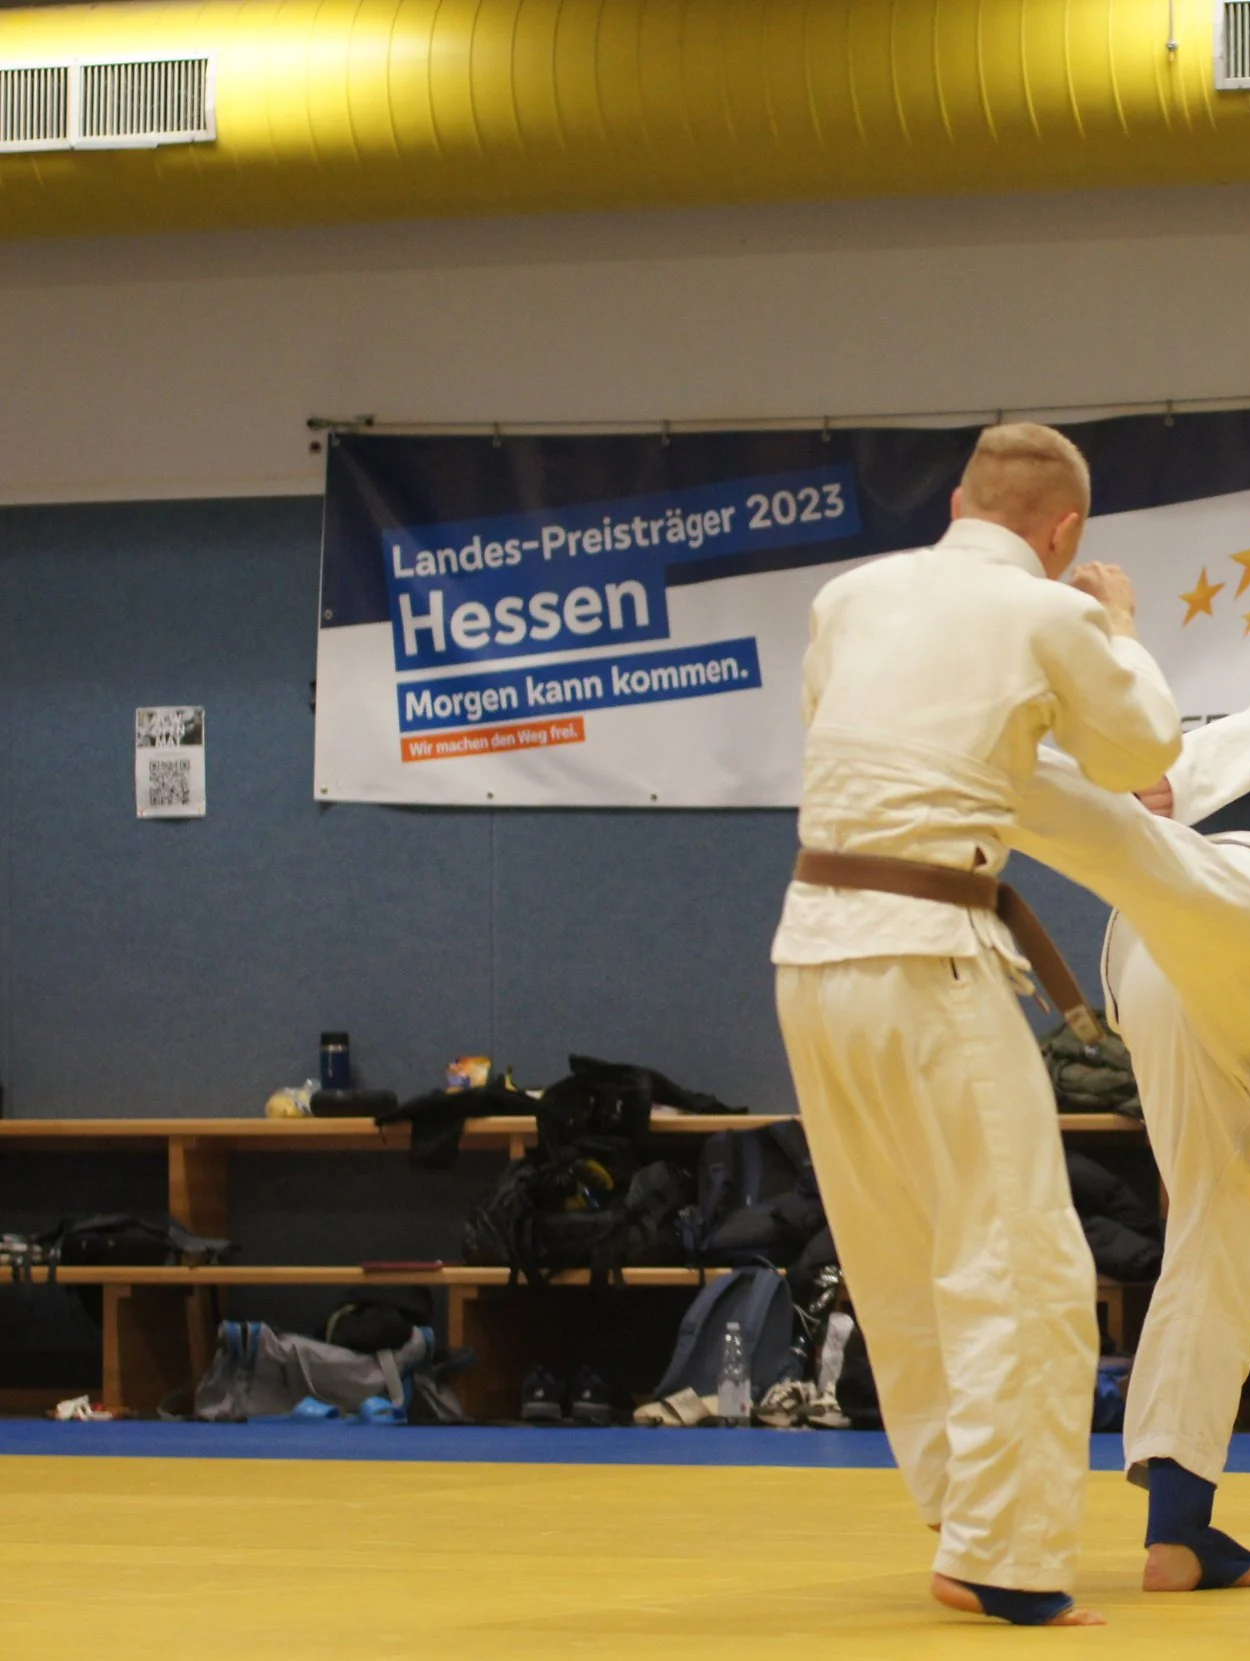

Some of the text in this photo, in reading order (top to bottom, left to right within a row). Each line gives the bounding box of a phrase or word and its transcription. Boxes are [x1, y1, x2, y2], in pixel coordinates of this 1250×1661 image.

[392, 482, 845, 580] Landes-Preisträger 2023
[397, 577, 651, 657] Hessen
[404, 655, 750, 722] Morgen kann kommen.
[409, 722, 579, 758] Wir machen den Weg frei.
